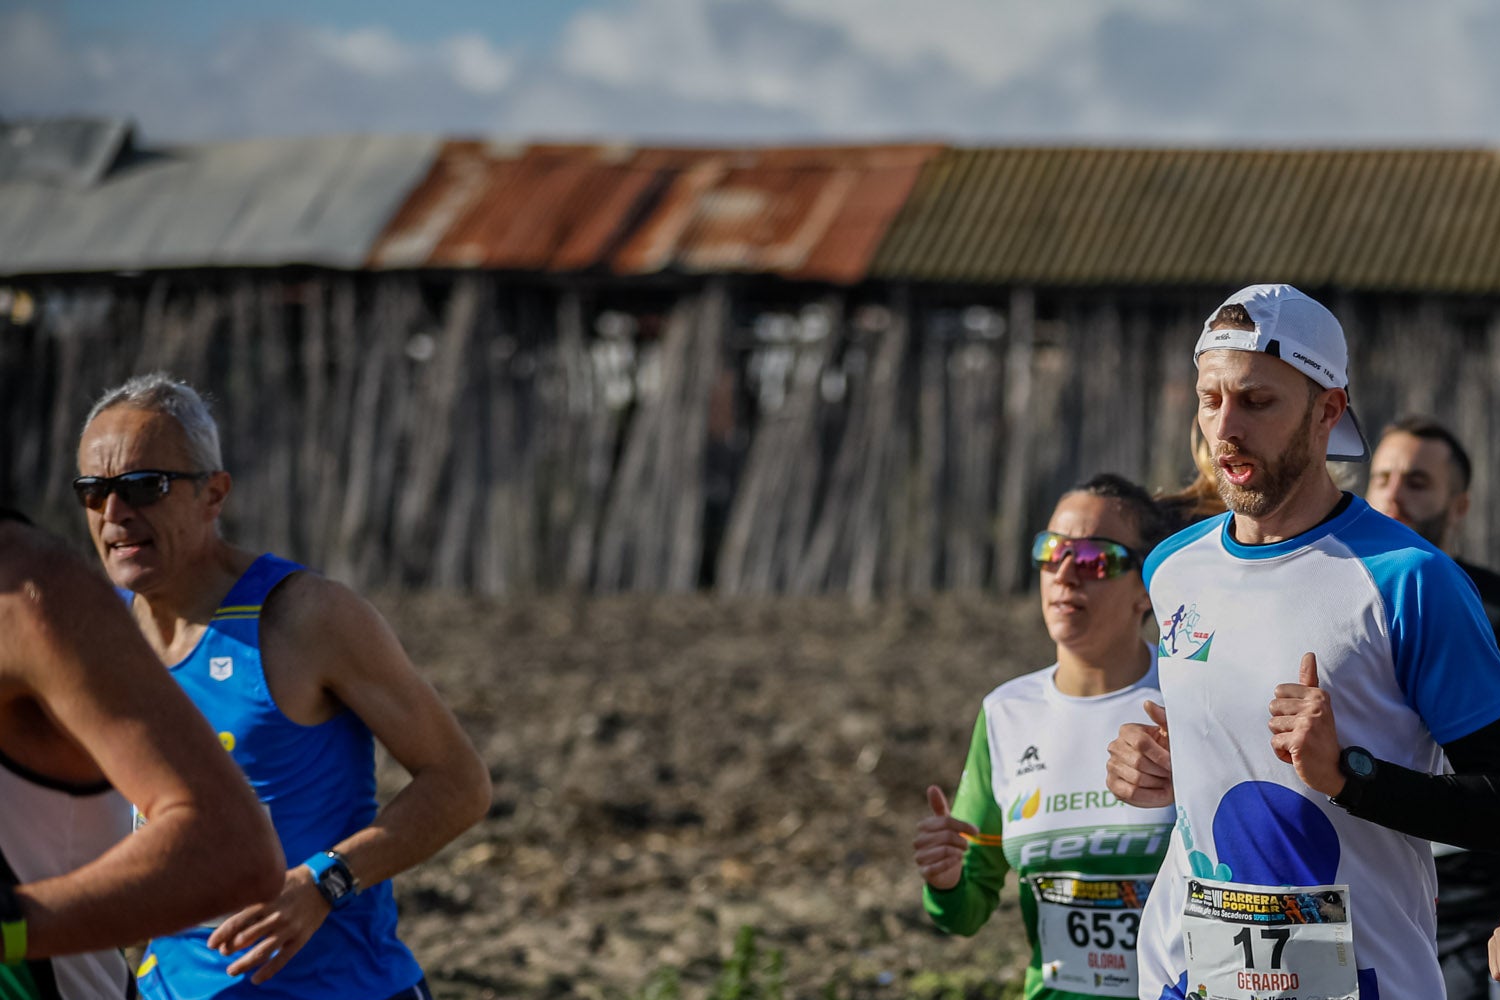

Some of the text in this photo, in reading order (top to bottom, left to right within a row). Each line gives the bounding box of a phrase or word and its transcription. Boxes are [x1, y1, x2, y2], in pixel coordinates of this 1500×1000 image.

[1045, 790, 1125, 814] IBERD
[1211, 889, 1223, 909] VII
[1222, 890, 1280, 905] CARRERA
[1222, 901, 1281, 913] POPULAR
[1211, 908, 1221, 917] los
[1221, 908, 1253, 921] Secaderos
[1066, 911, 1139, 951] 653
[1233, 926, 1291, 970] 17
[1237, 972, 1299, 991] GERARDO
